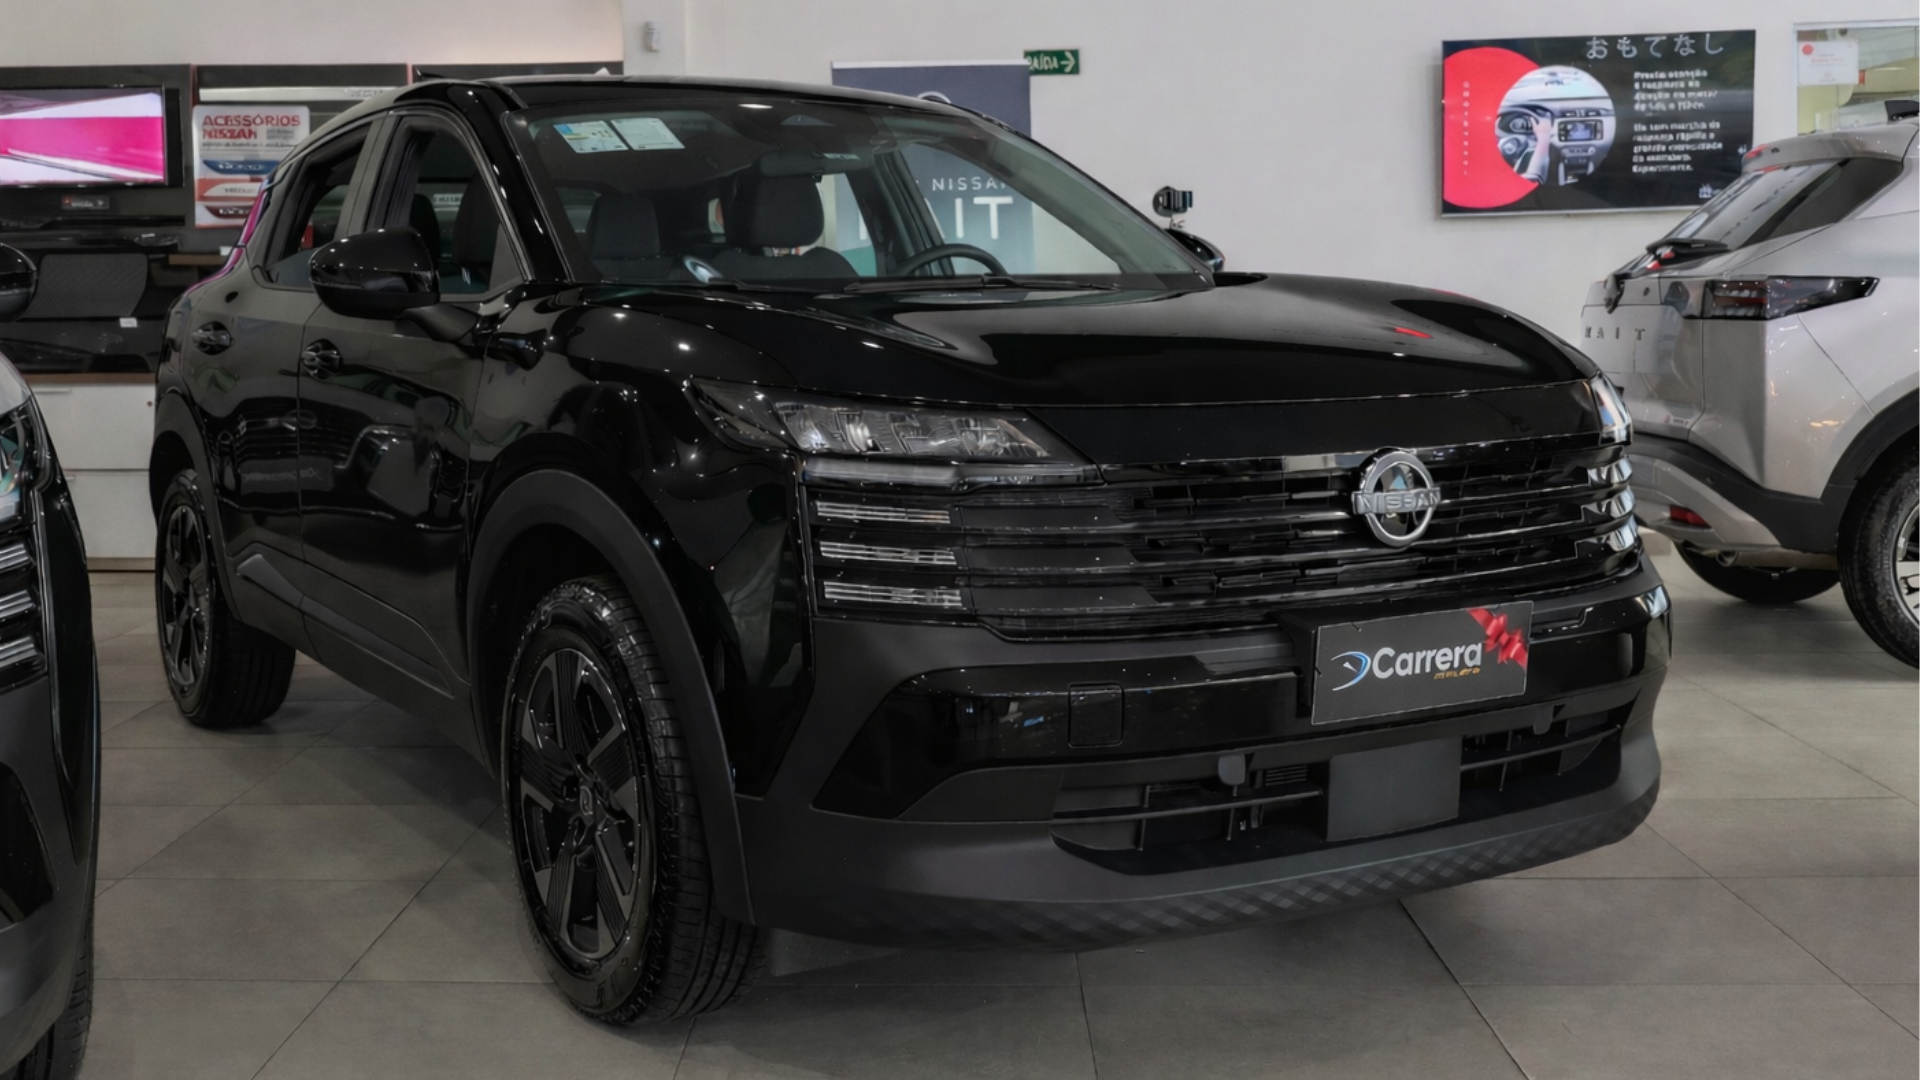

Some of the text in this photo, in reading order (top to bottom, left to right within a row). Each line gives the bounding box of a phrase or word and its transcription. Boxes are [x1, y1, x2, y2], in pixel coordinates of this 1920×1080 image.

[1586, 33, 1724, 59] おもてなし
[202, 114, 301, 127] ACESSÓRIOS
[1354, 489, 1438, 513] NISSAN
[1372, 642, 1482, 679] Carrera
